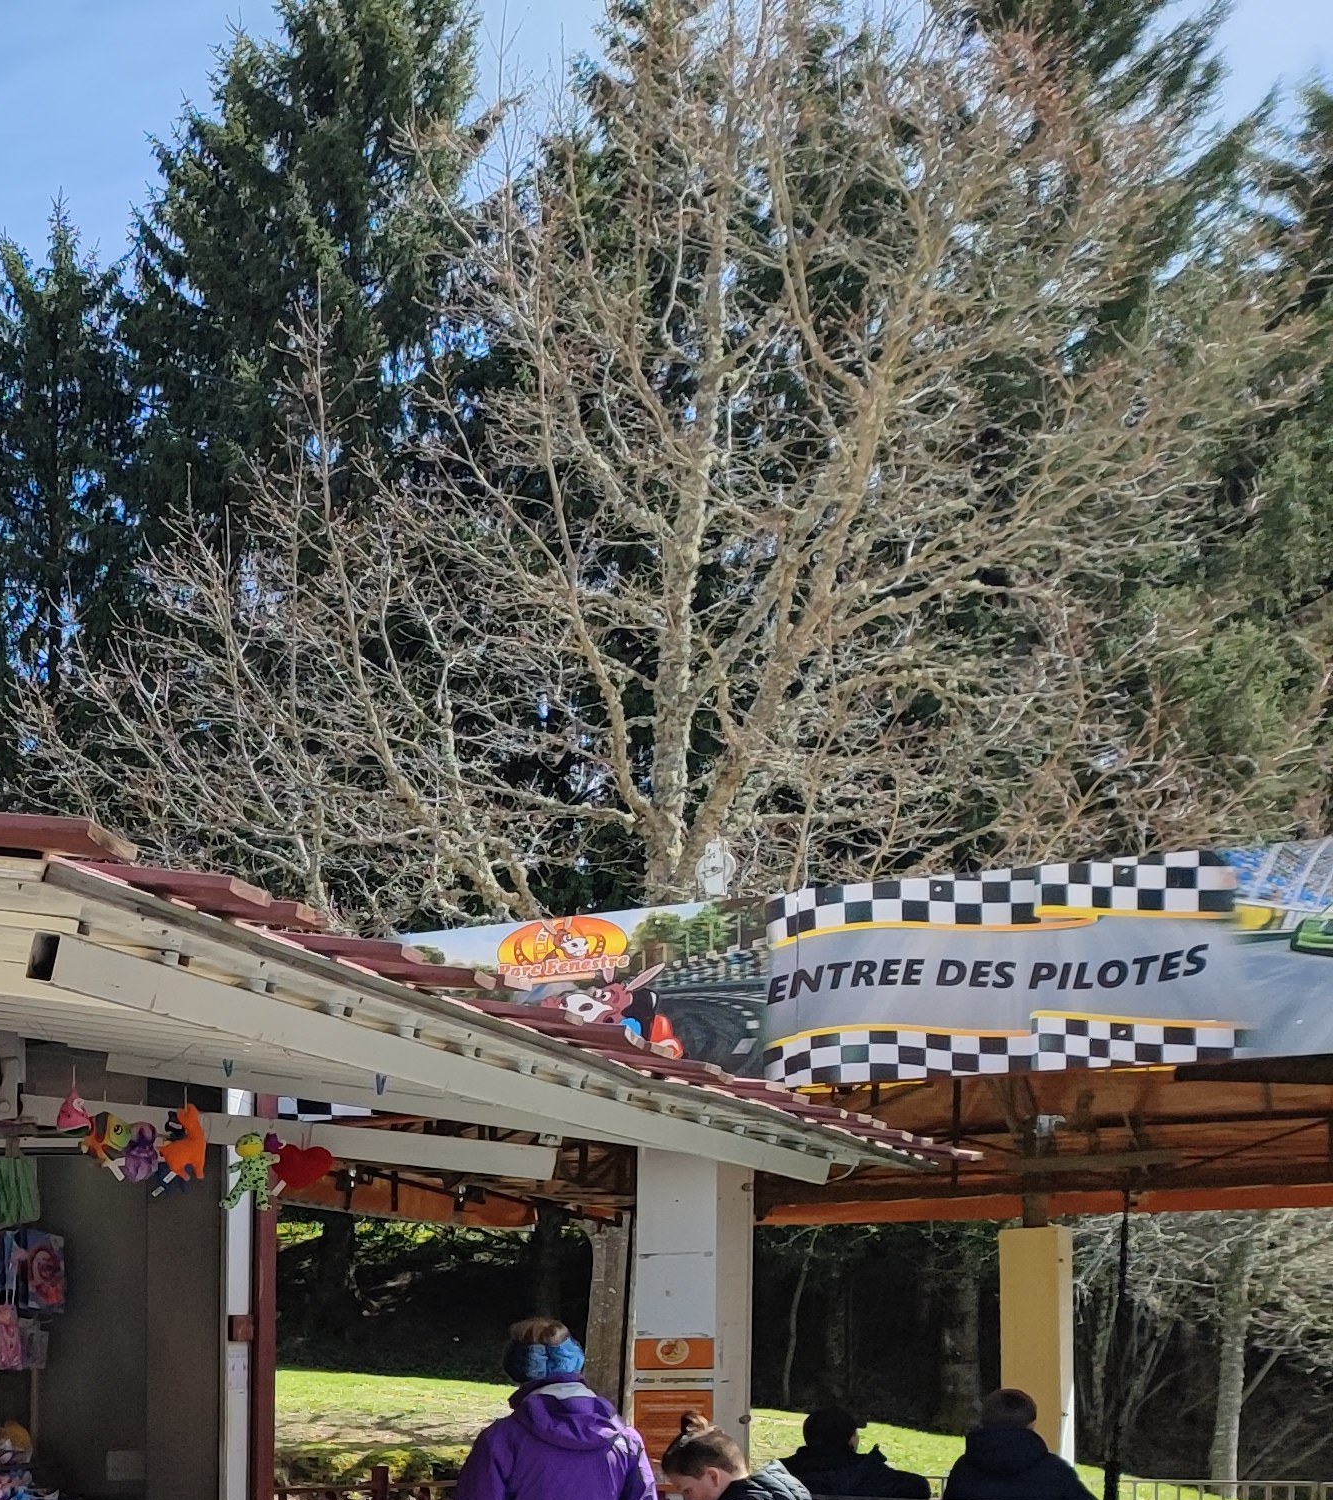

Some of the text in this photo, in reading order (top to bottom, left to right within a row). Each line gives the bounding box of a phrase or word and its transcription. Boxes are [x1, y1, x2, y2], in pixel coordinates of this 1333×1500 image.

[498, 954, 630, 979] Parc Fenestre
[766, 944, 1210, 1006] ENTREE DES PILOTES
